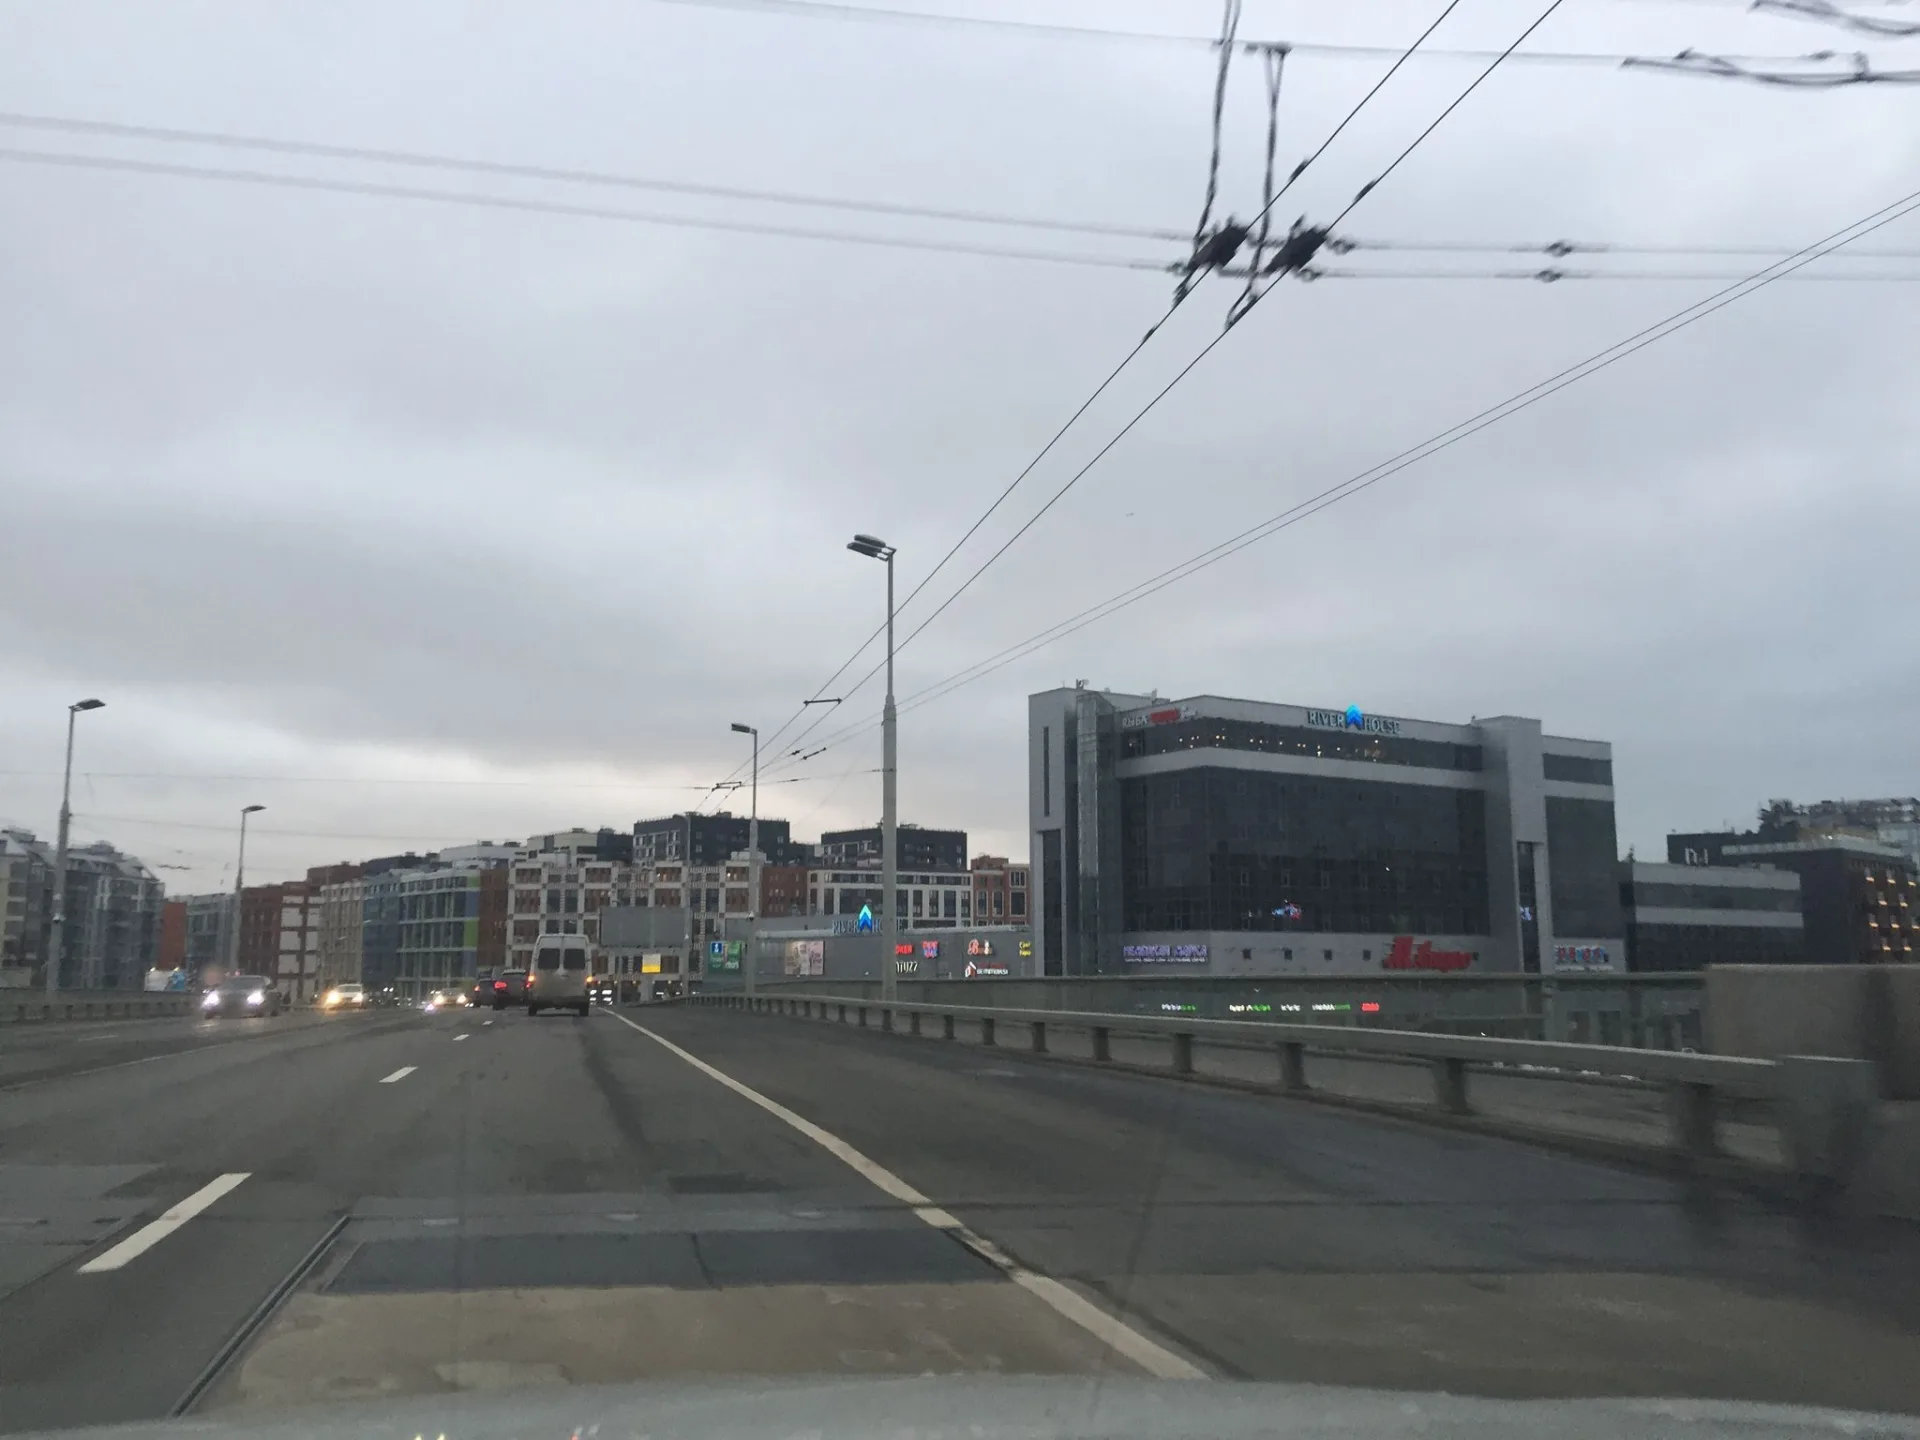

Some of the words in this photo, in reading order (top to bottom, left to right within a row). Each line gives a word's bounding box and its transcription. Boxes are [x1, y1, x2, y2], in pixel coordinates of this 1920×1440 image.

[1307, 711, 1345, 728] RIVER
[1363, 715, 1402, 735] HOUSE
[832, 919, 860, 936] RIVER
